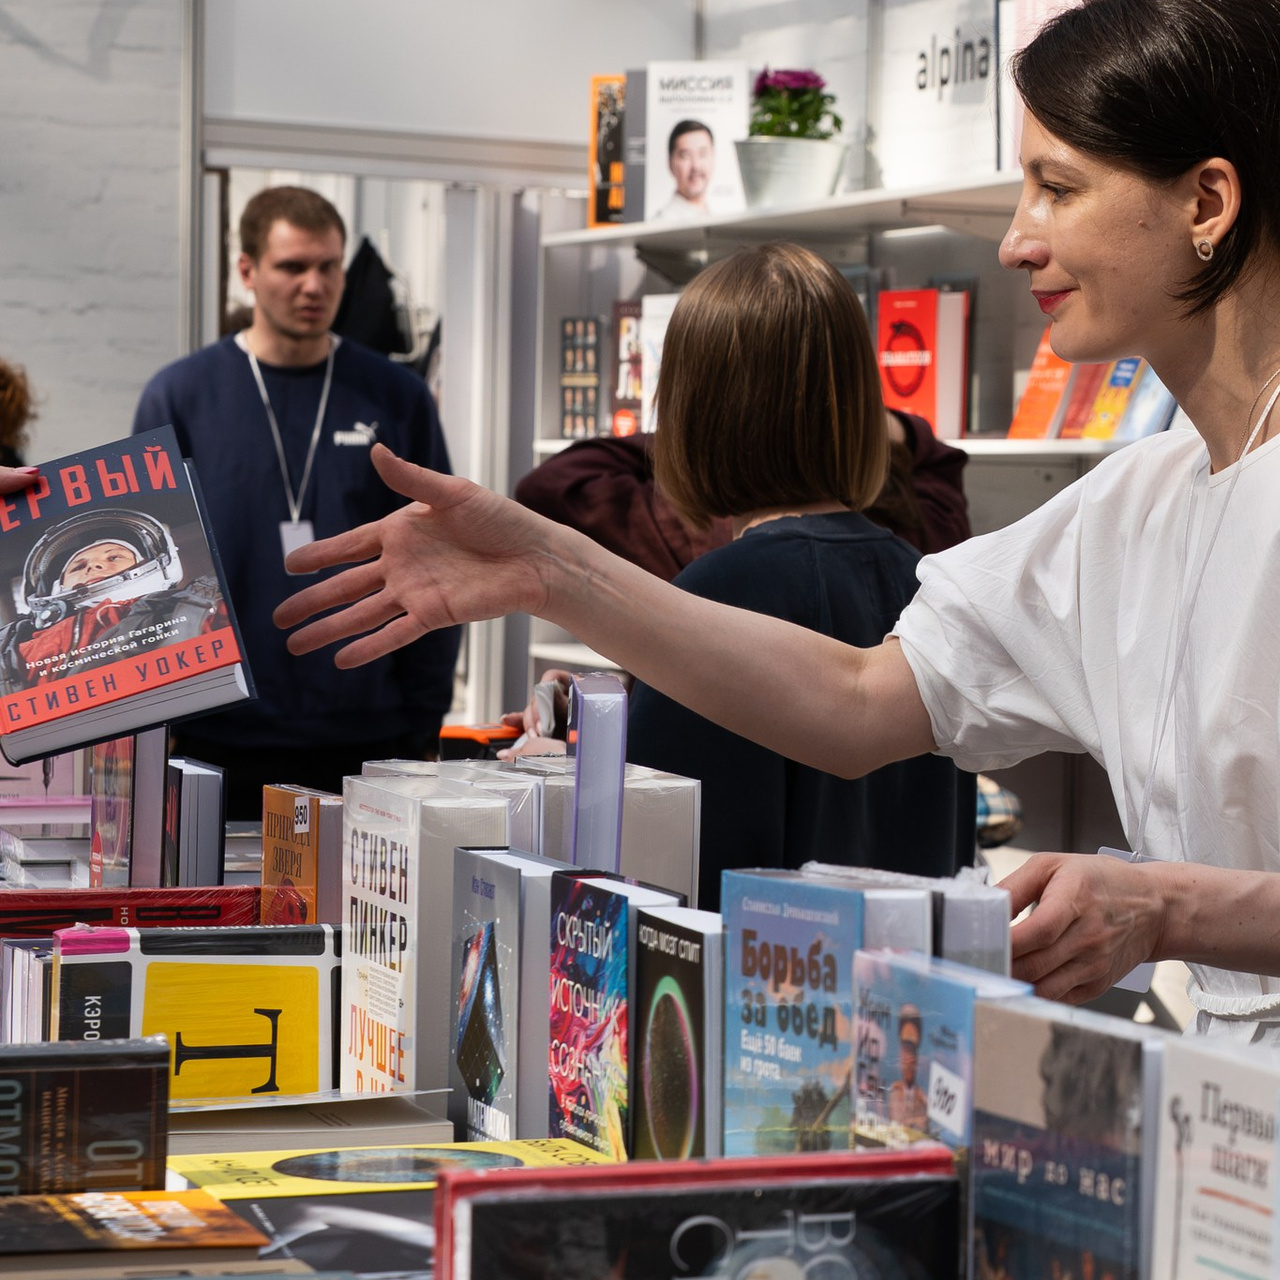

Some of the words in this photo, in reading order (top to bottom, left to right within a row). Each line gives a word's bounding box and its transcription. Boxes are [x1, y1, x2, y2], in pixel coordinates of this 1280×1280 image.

[659, 75, 734, 91] МИССИЯ
[917, 28, 991, 101] alpina
[26, 651, 67, 670] Новая
[70, 634, 125, 659] история
[128, 615, 188, 644] Гагарина
[51, 641, 139, 674] космической
[140, 627, 180, 650] гонки
[8, 673, 118, 723] СТИВЕН
[135, 638, 225, 683] УОКЕР
[294, 804, 308, 826] 950
[272, 845, 302, 880] ЗВЕРЯ
[350, 826, 409, 905] СТИВЕН
[349, 896, 408, 974] ПИНКЕР
[556, 911, 614, 963] СКРЫТЫЙ
[638, 923, 660, 950] КОГДА
[659, 930, 679, 956] МОЗГ
[678, 936, 702, 964] СПИТ
[741, 927, 838, 994] Борьба
[551, 971, 620, 1033] ИСТОЧНИК
[741, 988, 767, 1028] за
[776, 988, 838, 1052] обед
[348, 1003, 406, 1084] ЛУЧШЕЕ
[740, 1029, 763, 1053] Ещё
[763, 1033, 777, 1056] 50
[776, 1036, 803, 1064] баек
[984, 1137, 1034, 1185] мир
[1078, 1165, 1127, 1207] нас
